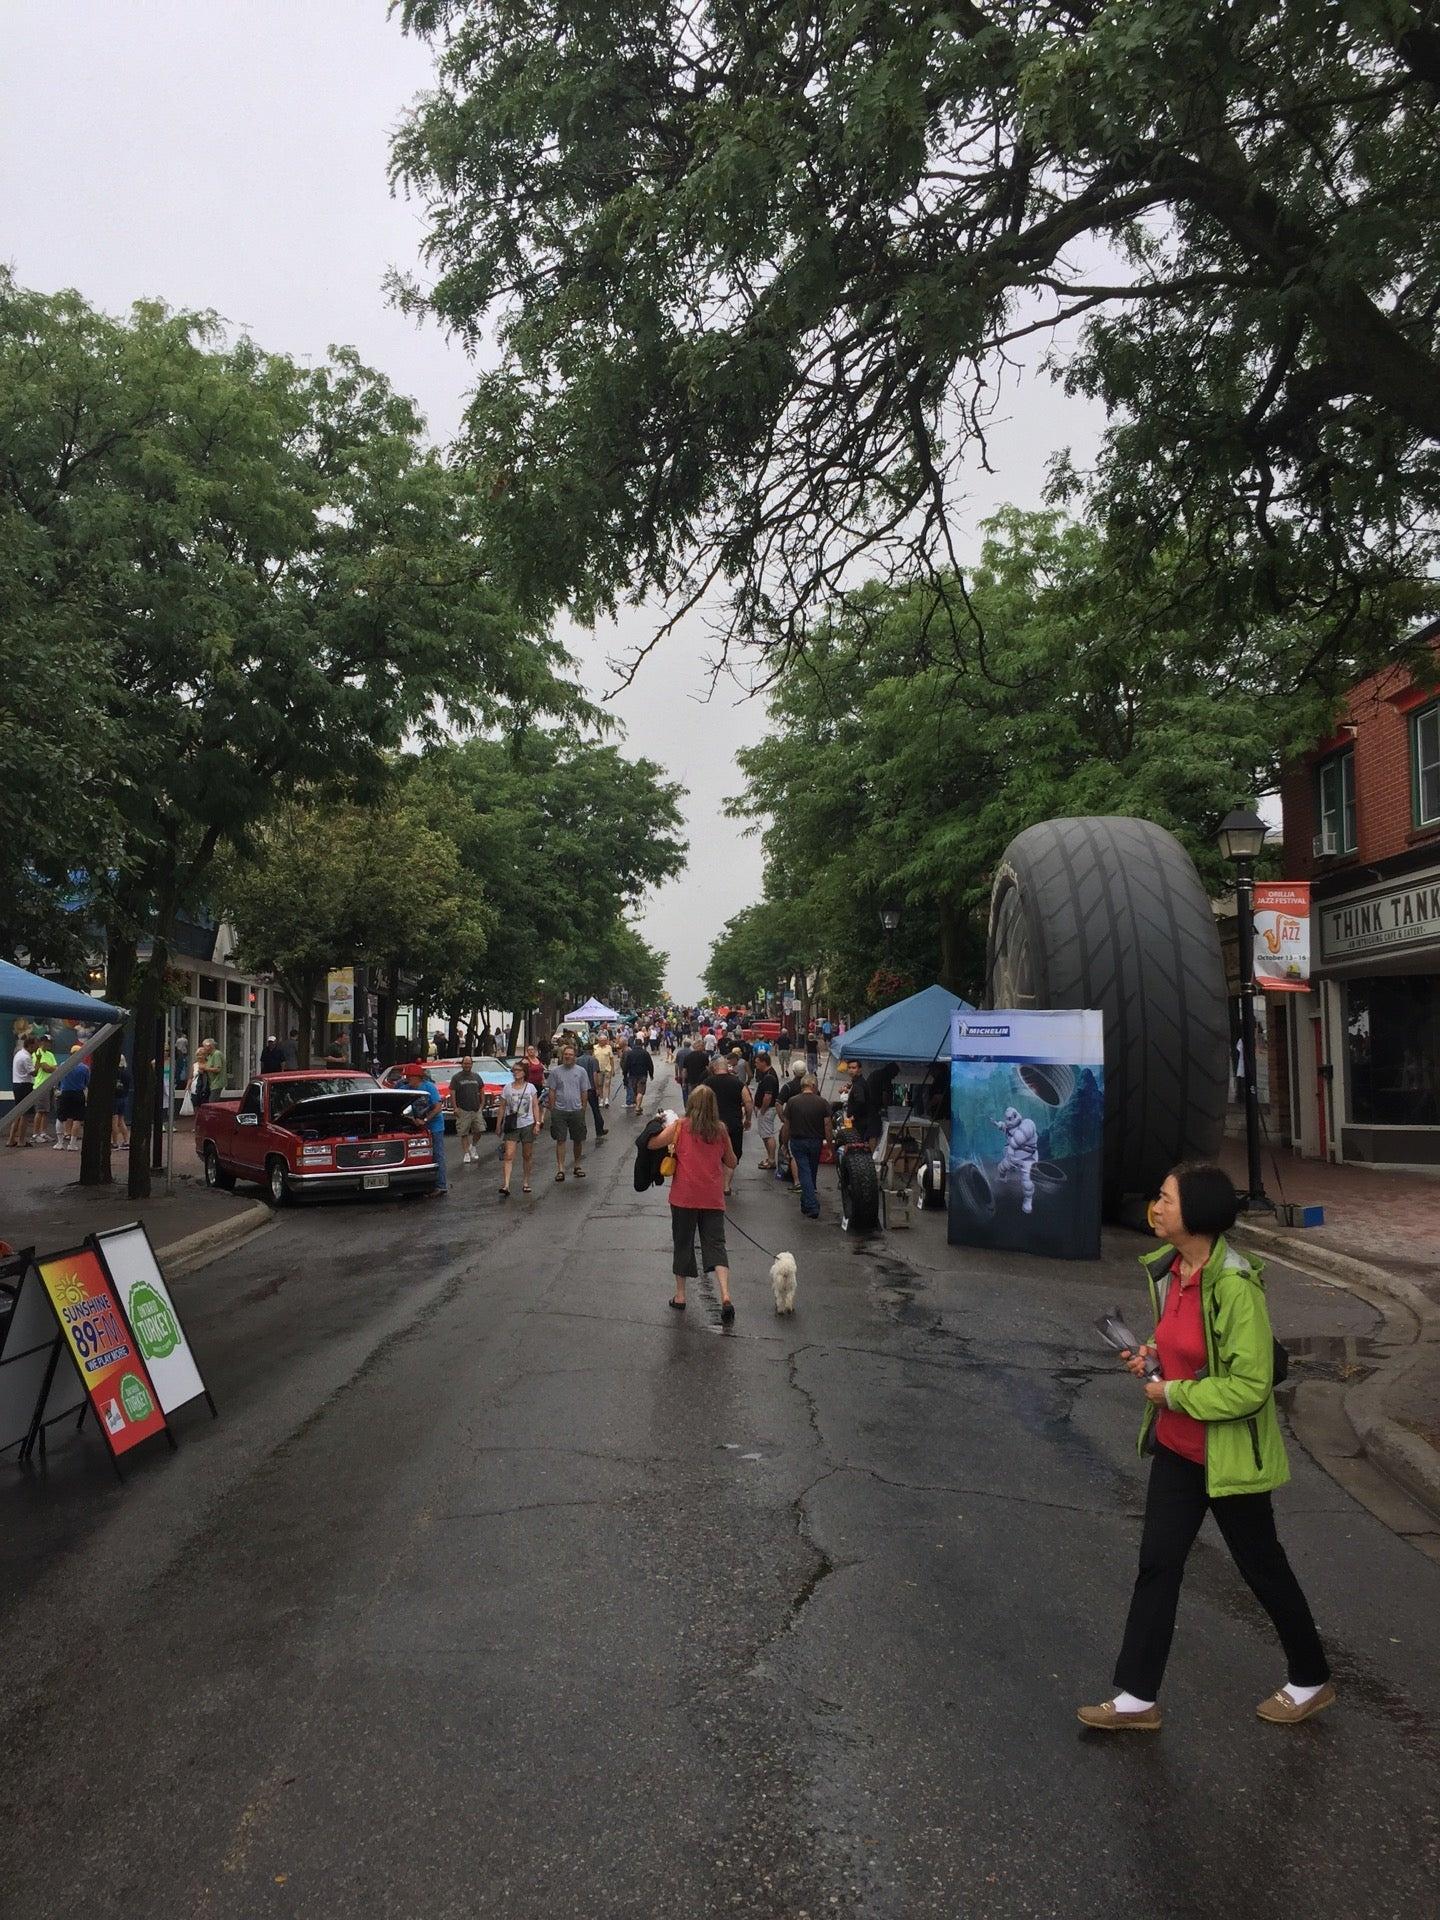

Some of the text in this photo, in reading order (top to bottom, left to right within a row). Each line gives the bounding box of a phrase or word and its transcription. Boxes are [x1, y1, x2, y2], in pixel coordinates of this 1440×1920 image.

[1333, 887, 1440, 940] THINK TANK
[62, 1294, 112, 1323] SUNSHINE
[137, 1311, 172, 1344] TURKEY
[87, 1347, 129, 1371] WE PLAY MORE
